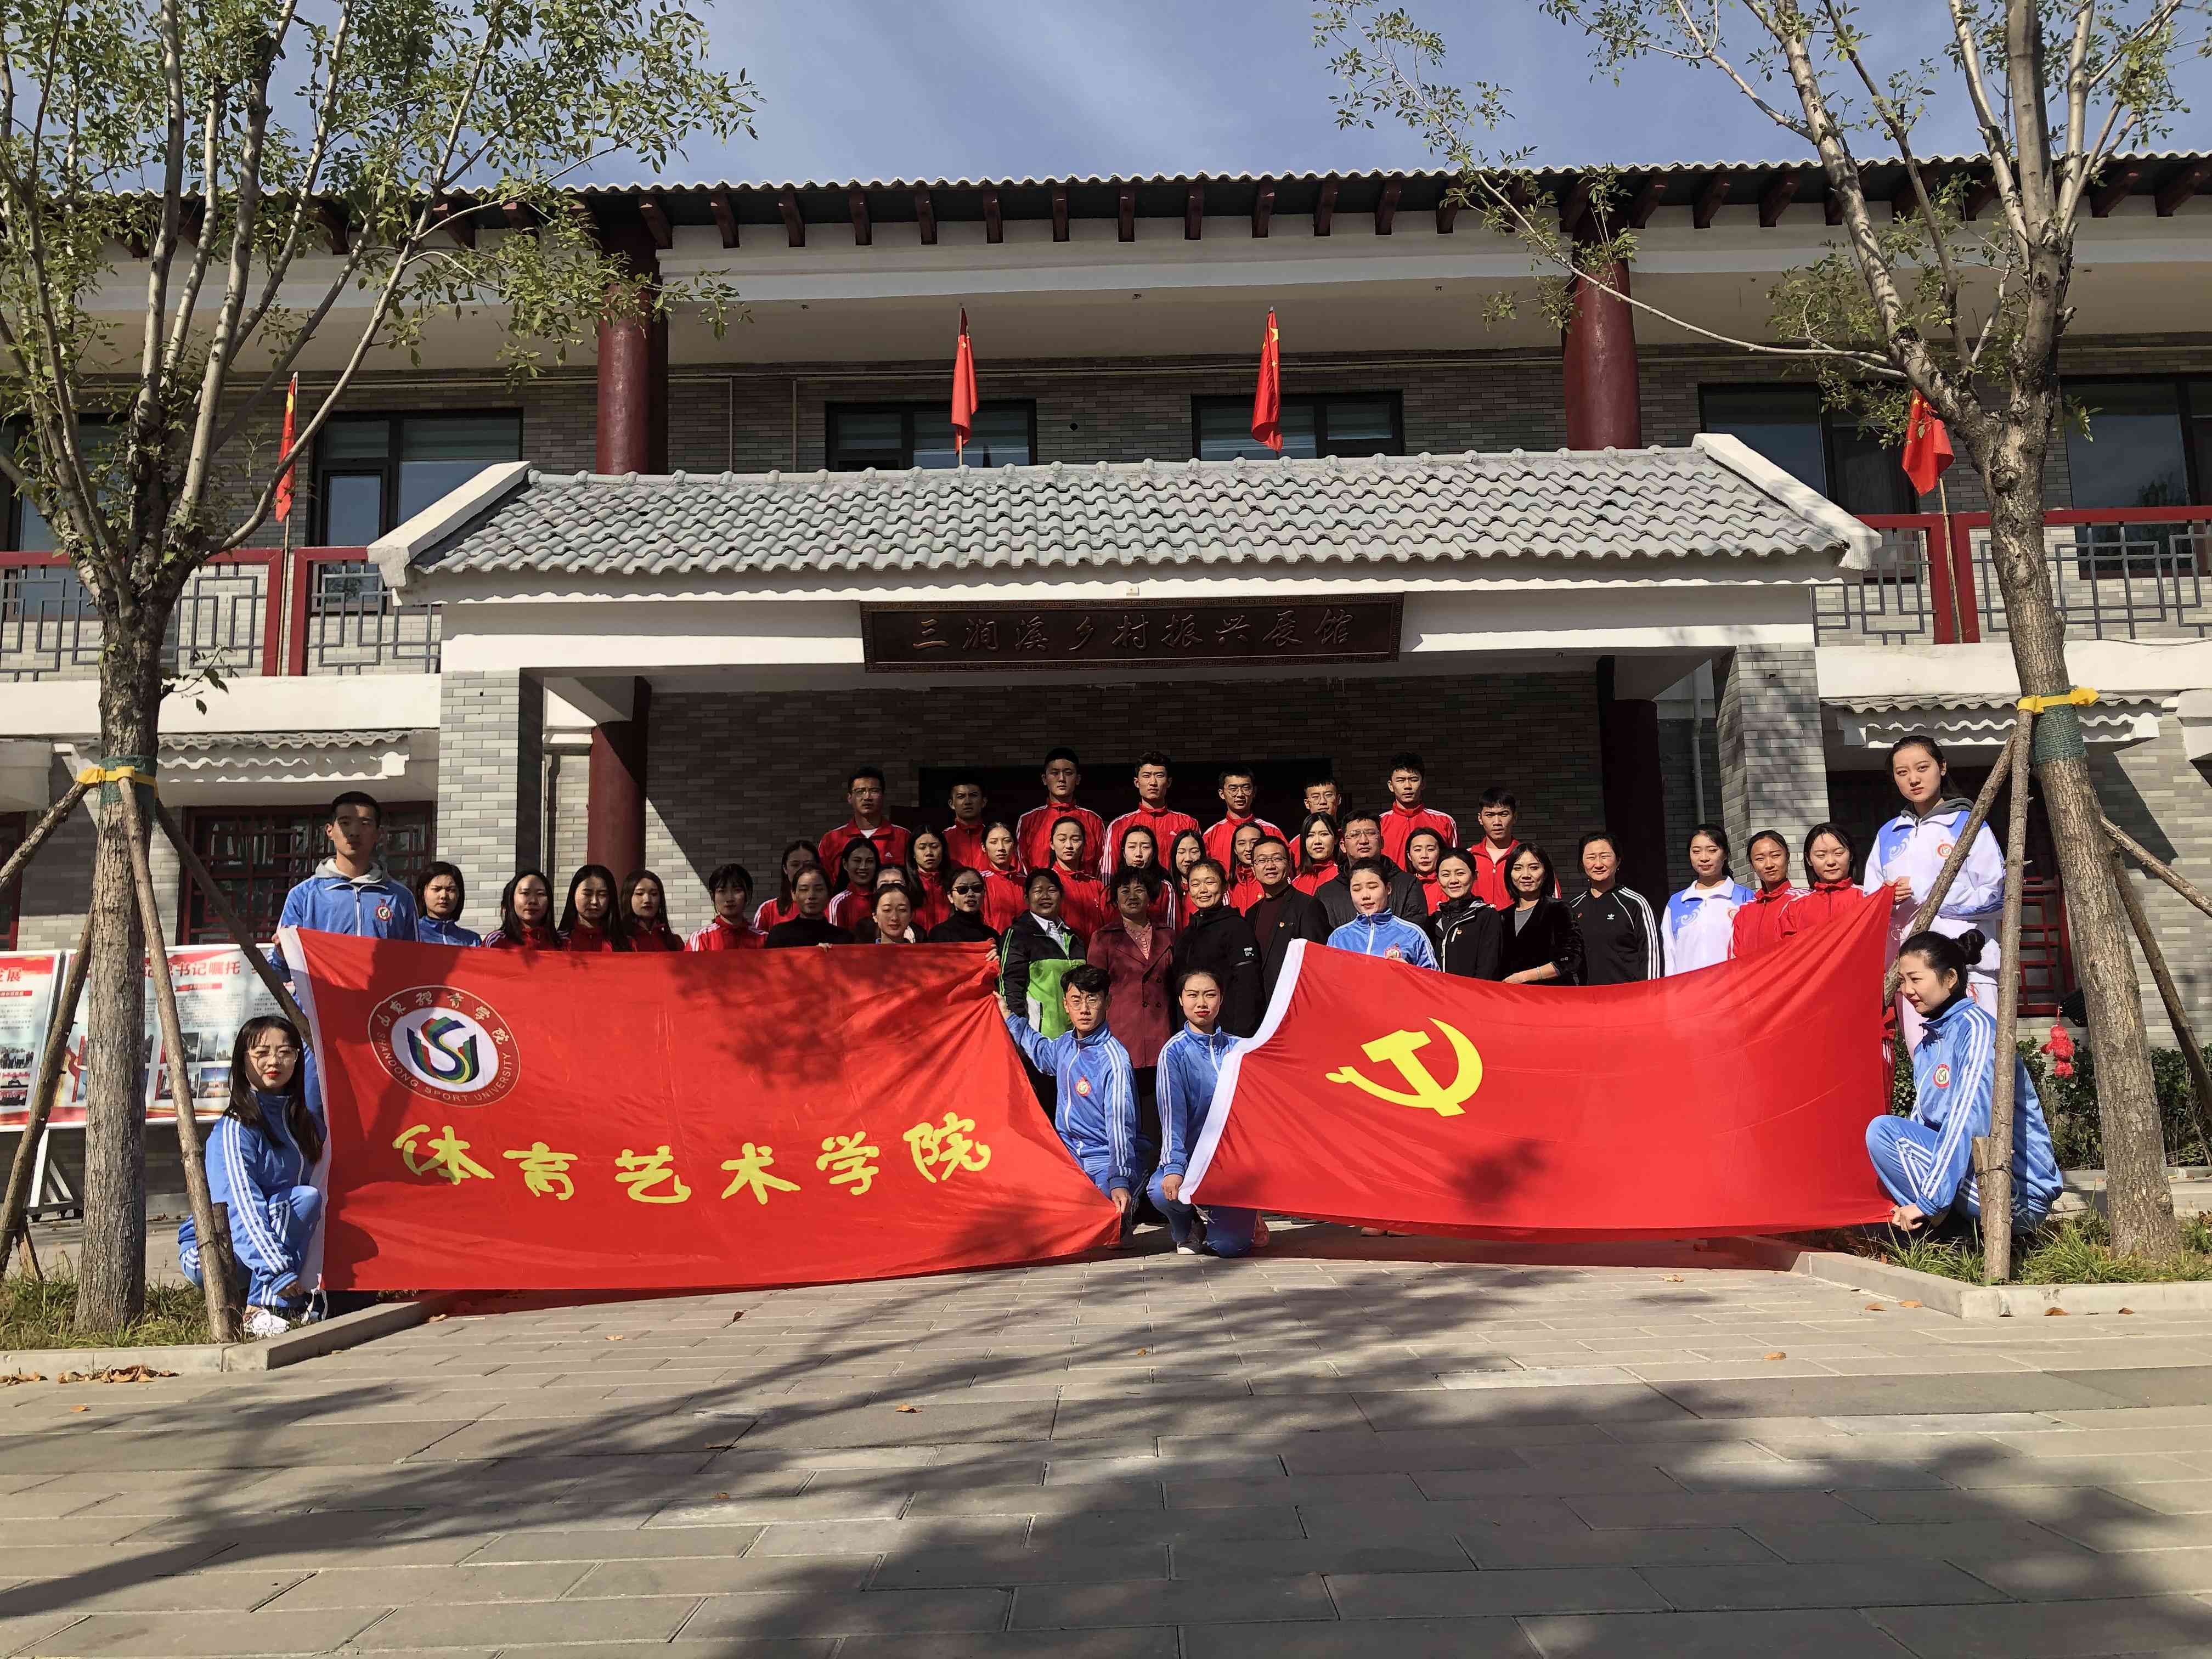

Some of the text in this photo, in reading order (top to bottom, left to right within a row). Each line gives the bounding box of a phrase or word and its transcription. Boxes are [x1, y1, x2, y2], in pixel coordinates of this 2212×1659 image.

[912, 609, 1354, 652] 三涧溪乡村振兴展馆
[377, 1031, 513, 1102] SHANDONG SPORT UNIVERSITY
[392, 1111, 991, 1205] 体育艺术学院
